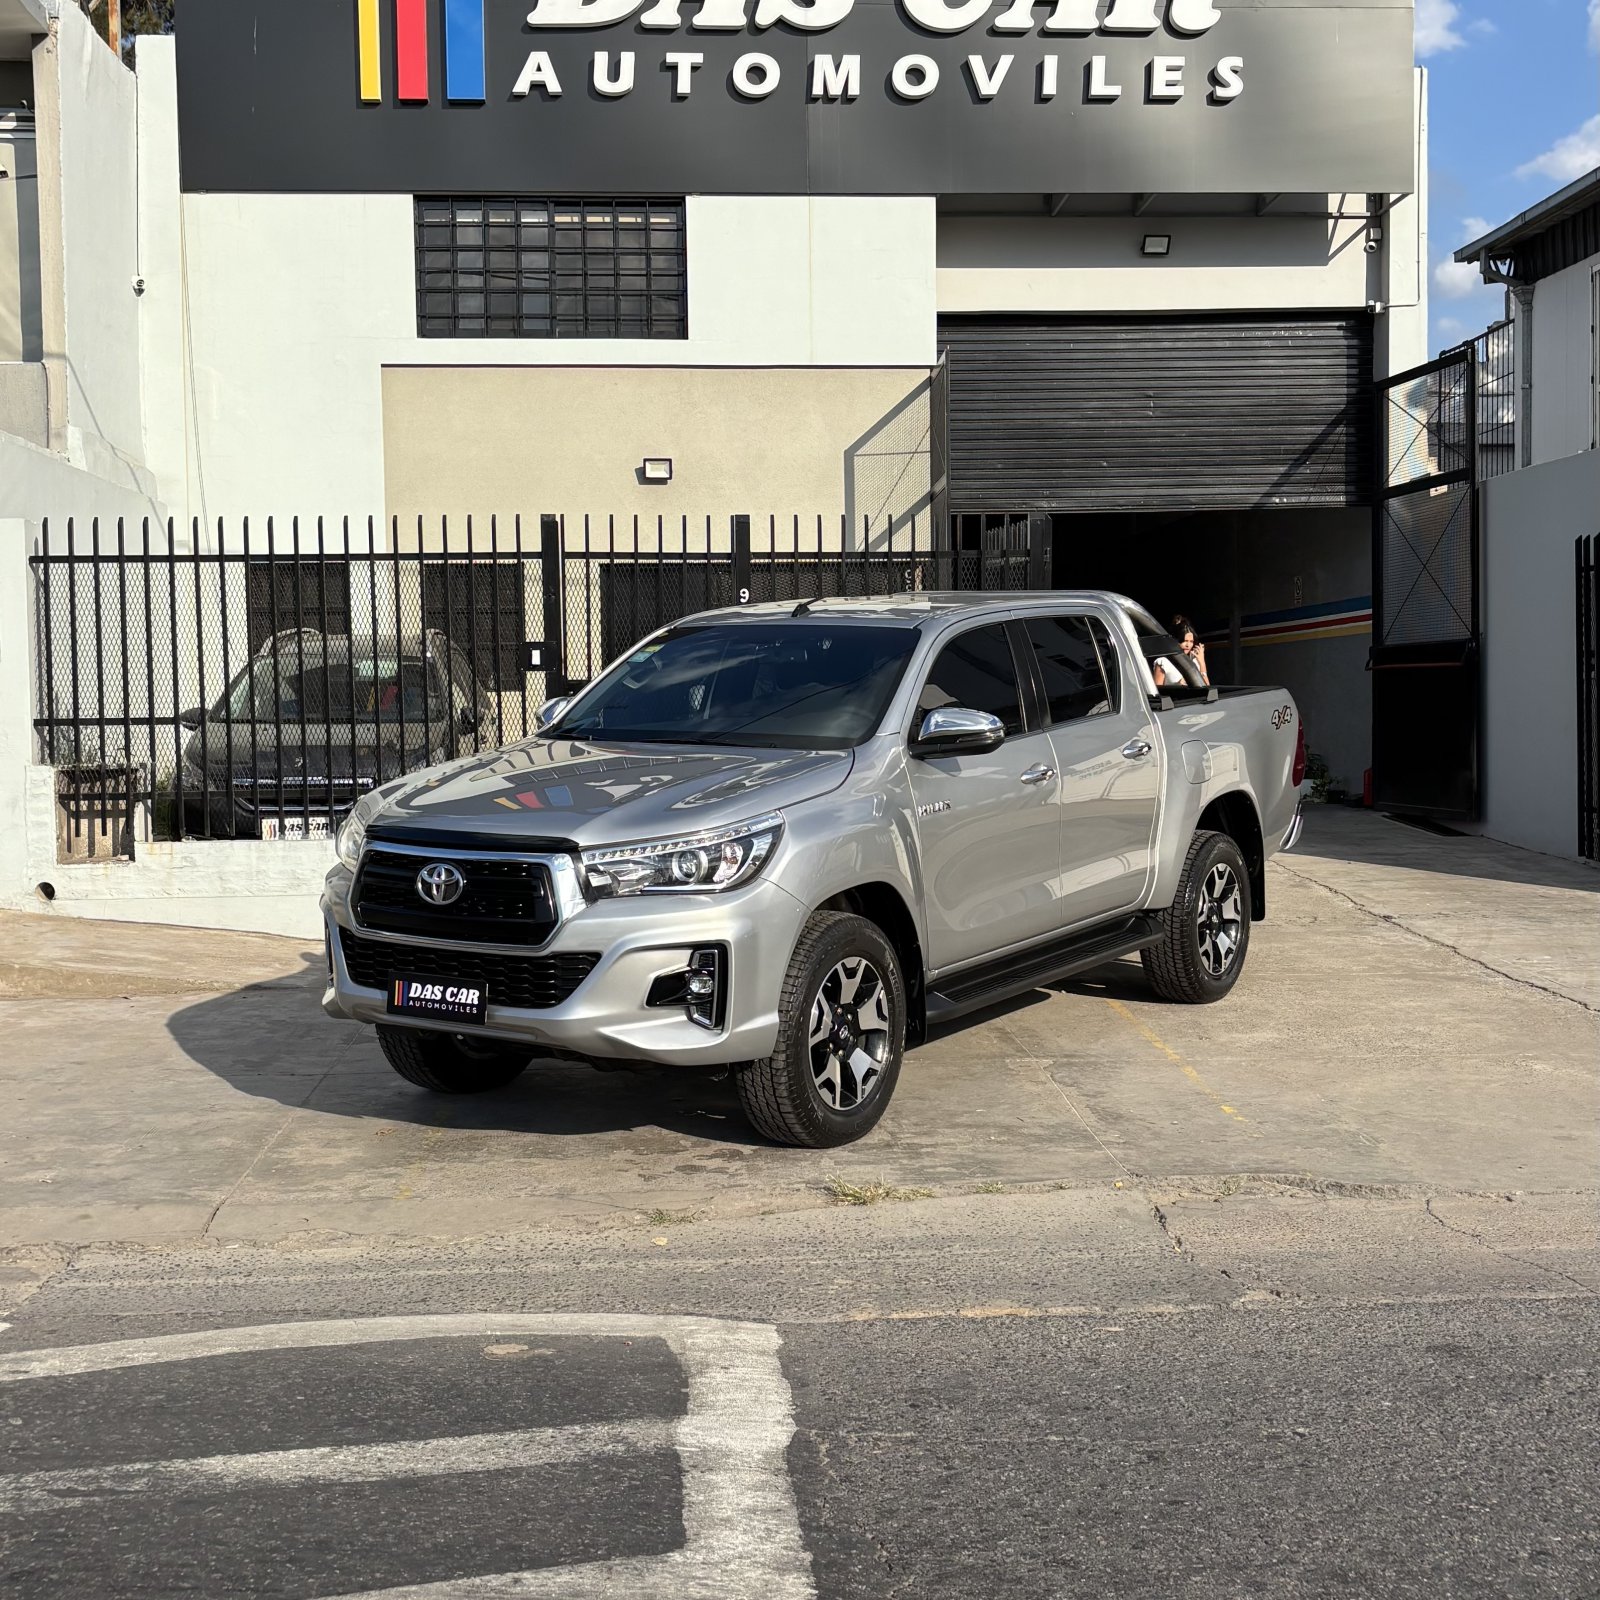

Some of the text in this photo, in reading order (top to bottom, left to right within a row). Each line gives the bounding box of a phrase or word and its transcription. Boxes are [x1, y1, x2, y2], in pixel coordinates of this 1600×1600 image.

[511, 51, 1245, 99] AUTOMOVILES
[739, 587, 750, 603] 9
[408, 982, 480, 1005] DAS CAR
[408, 1000, 477, 1014] AUTOMOVILES
